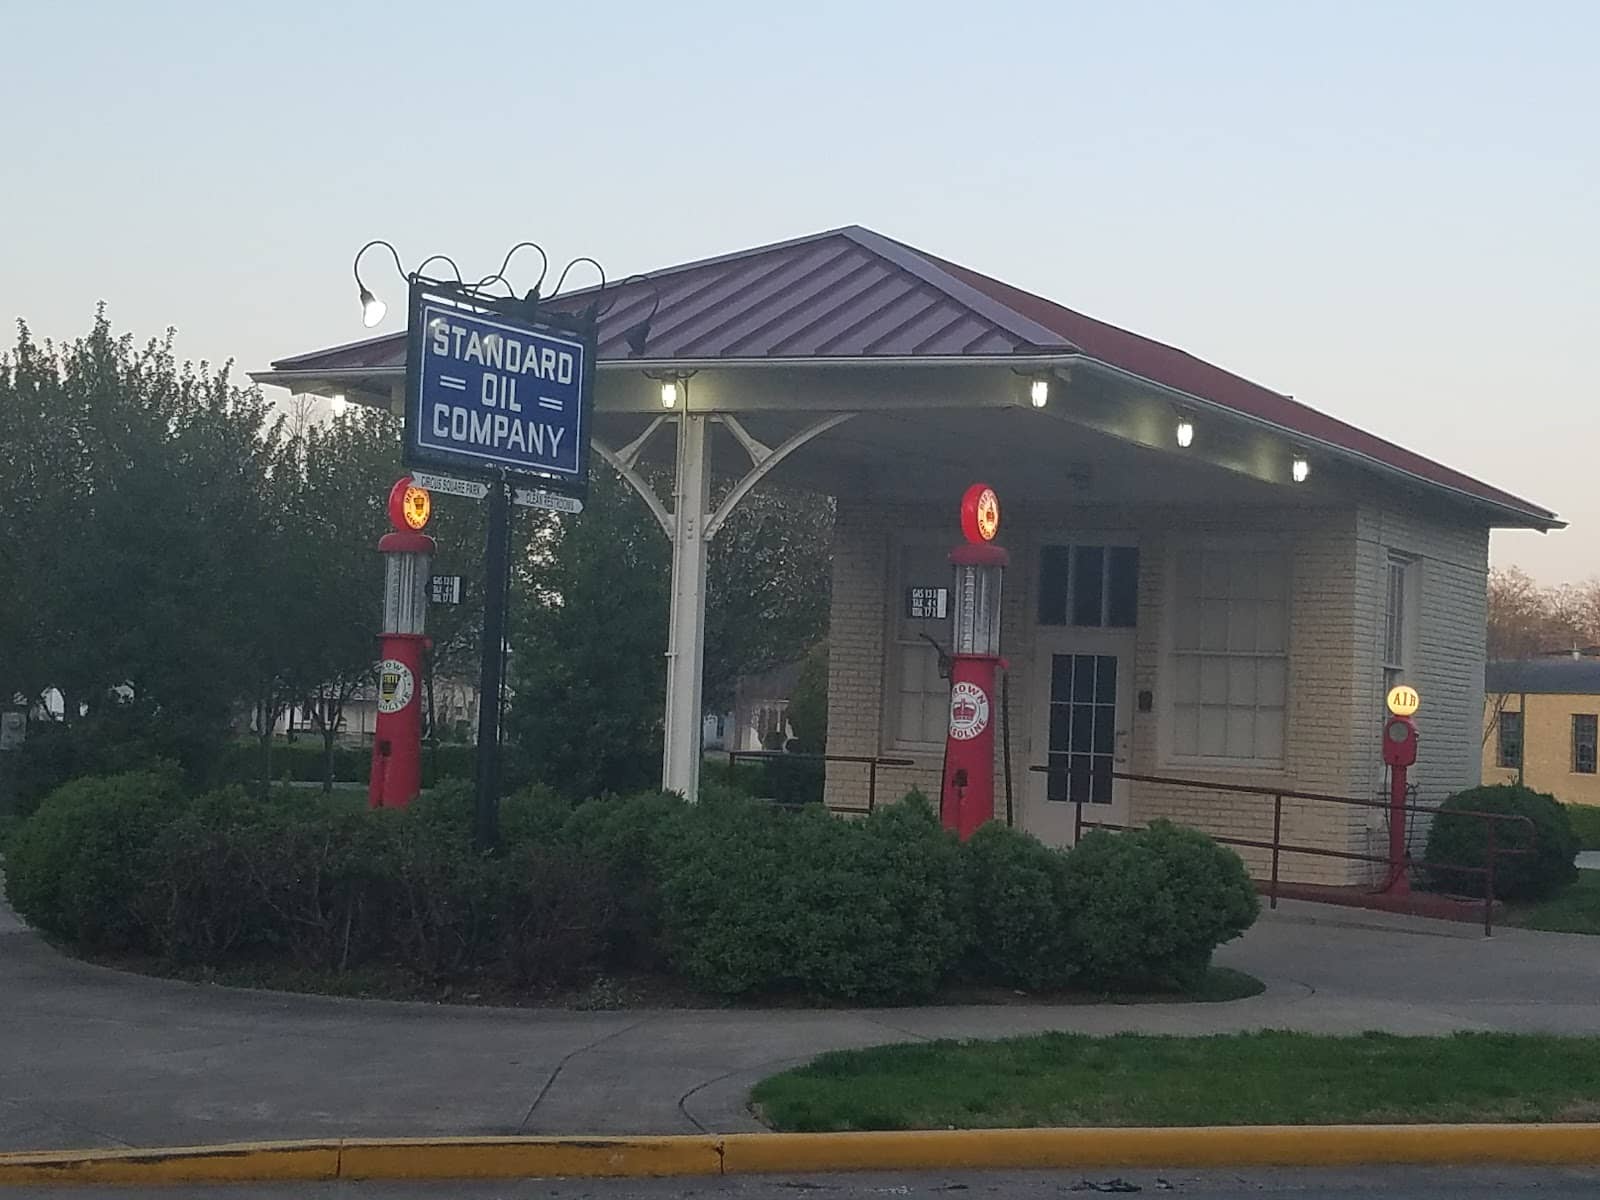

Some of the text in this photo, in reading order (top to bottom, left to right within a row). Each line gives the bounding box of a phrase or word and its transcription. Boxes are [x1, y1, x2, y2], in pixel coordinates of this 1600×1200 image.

[433, 323, 573, 385] STANDARD
[481, 372, 522, 412] OIL
[433, 403, 565, 458] COMPANY
[442, 479, 465, 494] SQUARE
[465, 483, 481, 496] PARK
[912, 588, 924, 598] GAS
[953, 684, 987, 705] ROWN
[1393, 691, 1417, 707] AIR
